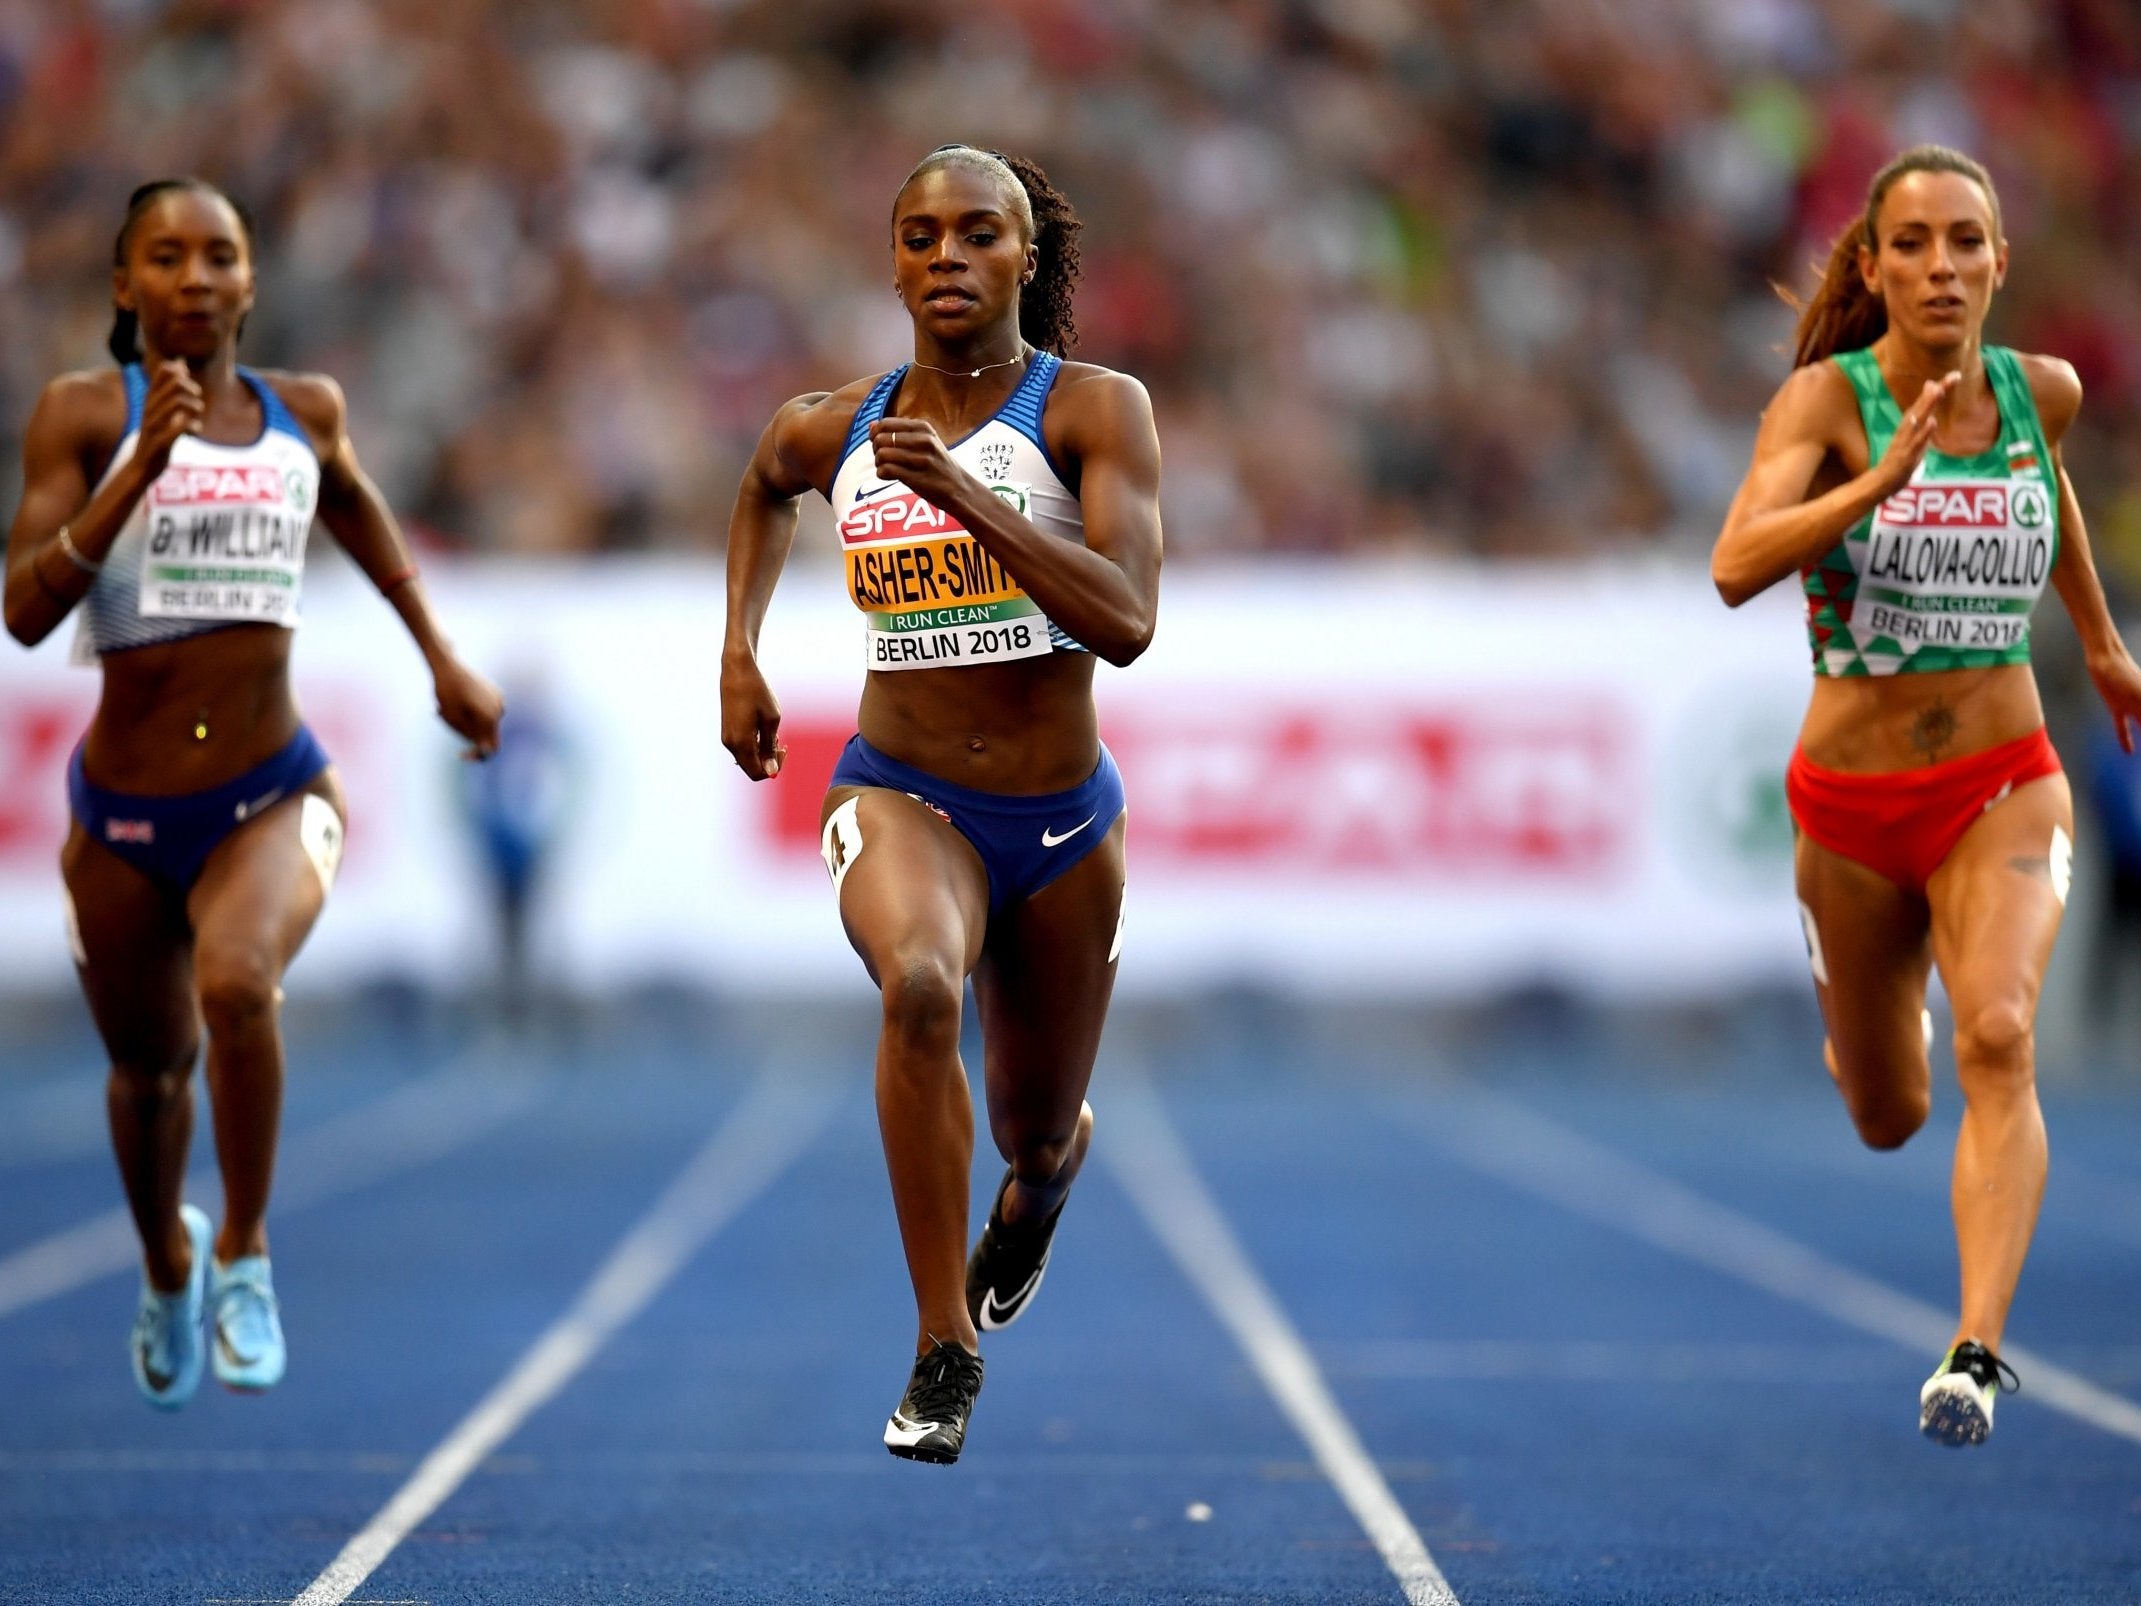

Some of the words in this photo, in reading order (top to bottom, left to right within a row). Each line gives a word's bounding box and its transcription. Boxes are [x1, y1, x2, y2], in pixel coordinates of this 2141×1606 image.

[1883, 488, 2005, 523] SPAR
[1869, 534, 2046, 586] LALOVA-COLLIO
[889, 615, 894, 630] I
[896, 612, 934, 630] RUN
[1871, 606, 1962, 642] BERLIN
[877, 631, 960, 662] BERLIN
[967, 624, 1031, 655] 2018
